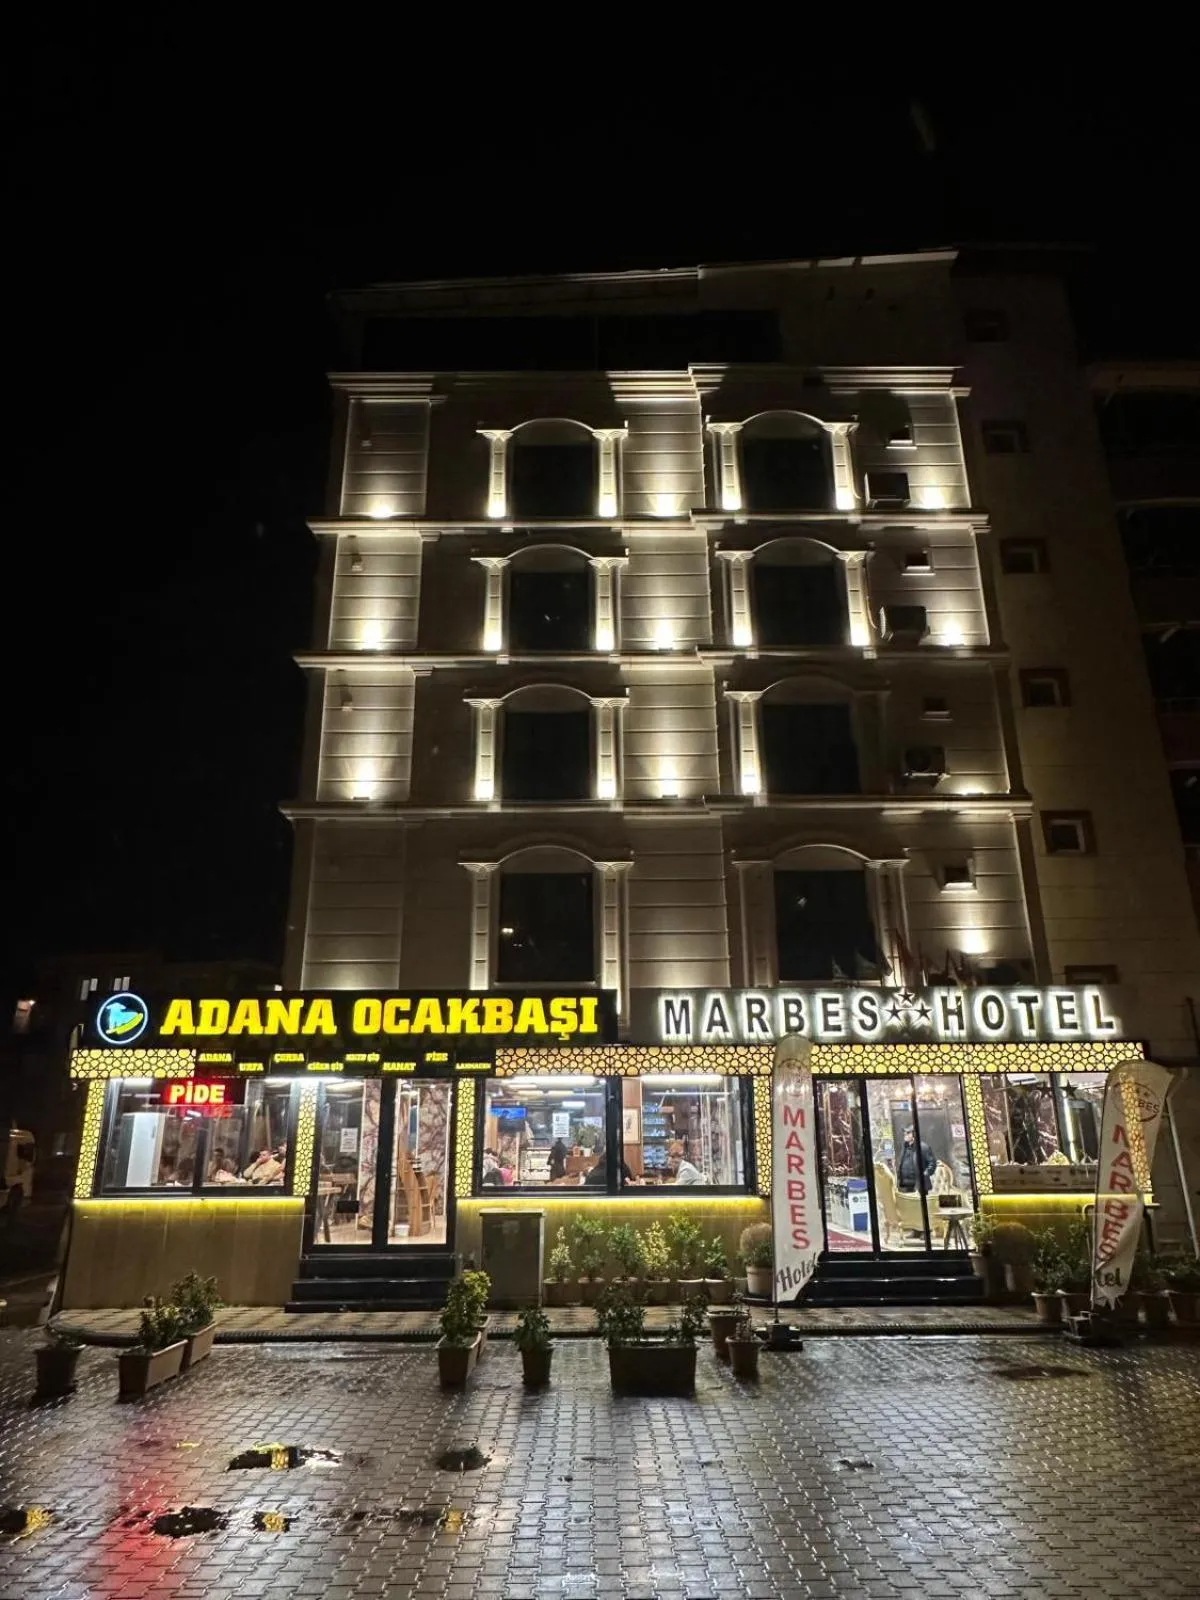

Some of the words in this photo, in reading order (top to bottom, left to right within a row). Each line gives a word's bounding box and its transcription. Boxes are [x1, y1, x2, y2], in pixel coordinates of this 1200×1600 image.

[159, 998, 338, 1036] ADANA
[352, 997, 598, 1041] OCAKBAŞI
[663, 994, 879, 1035] MARBES
[939, 992, 1115, 1033] HOTEL
[198, 1052, 233, 1063] ADANA
[169, 1079, 226, 1104] PİDE
[1138, 1098, 1160, 1114] BES
[782, 1105, 810, 1250] MARBES
